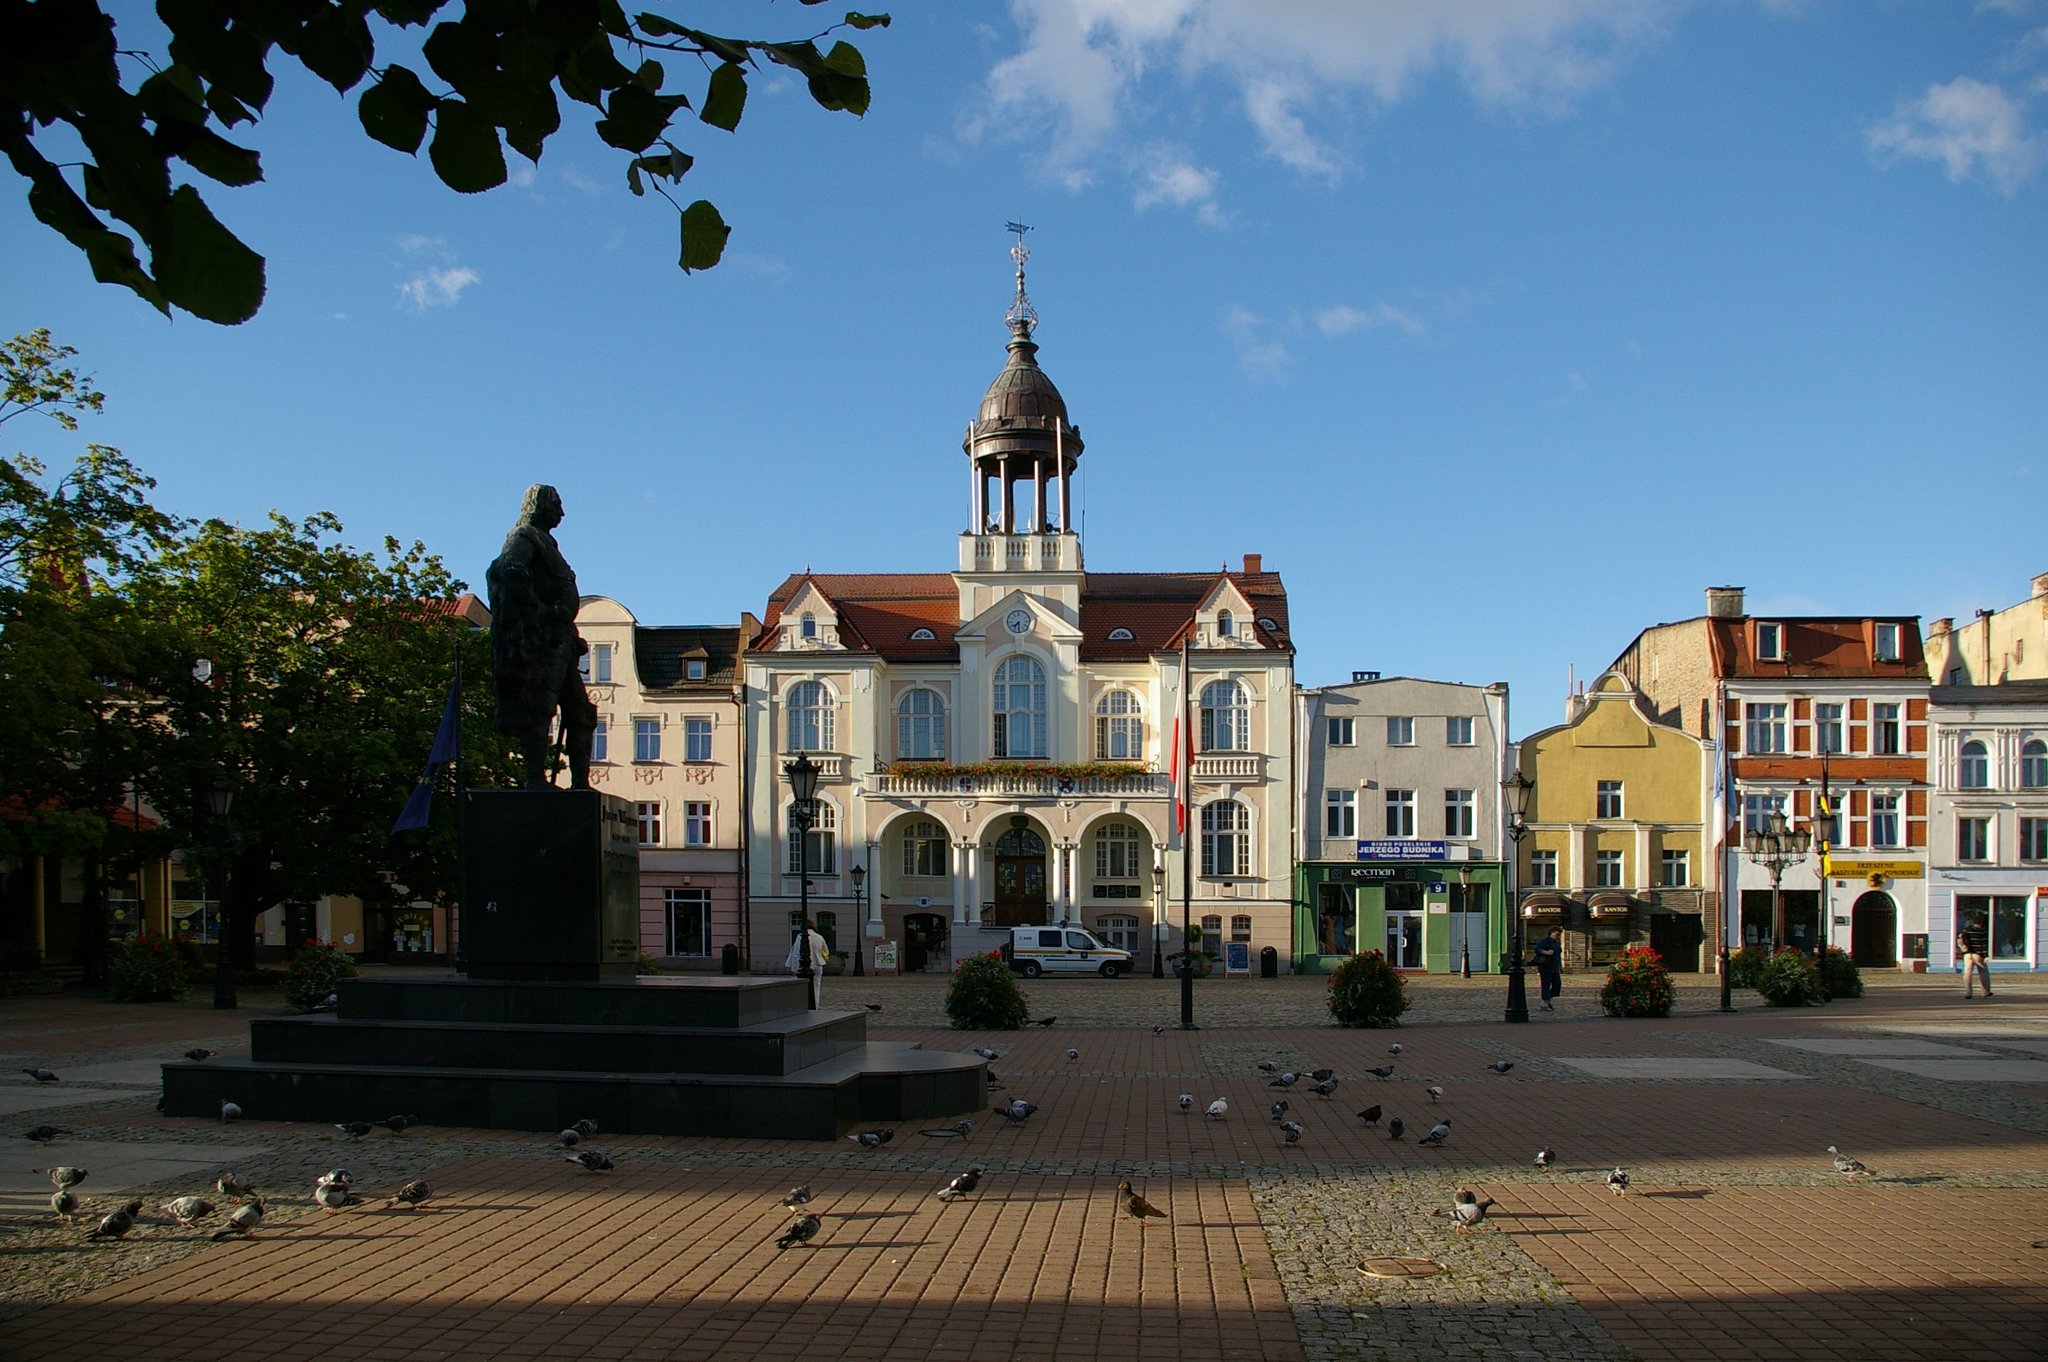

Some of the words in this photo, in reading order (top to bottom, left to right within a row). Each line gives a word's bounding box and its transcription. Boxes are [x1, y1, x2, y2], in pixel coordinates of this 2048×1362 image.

[1358, 846, 1400, 854] JERZEGO
[1402, 846, 1444, 854] BUDNIKA
[1434, 884, 1442, 893] 9
